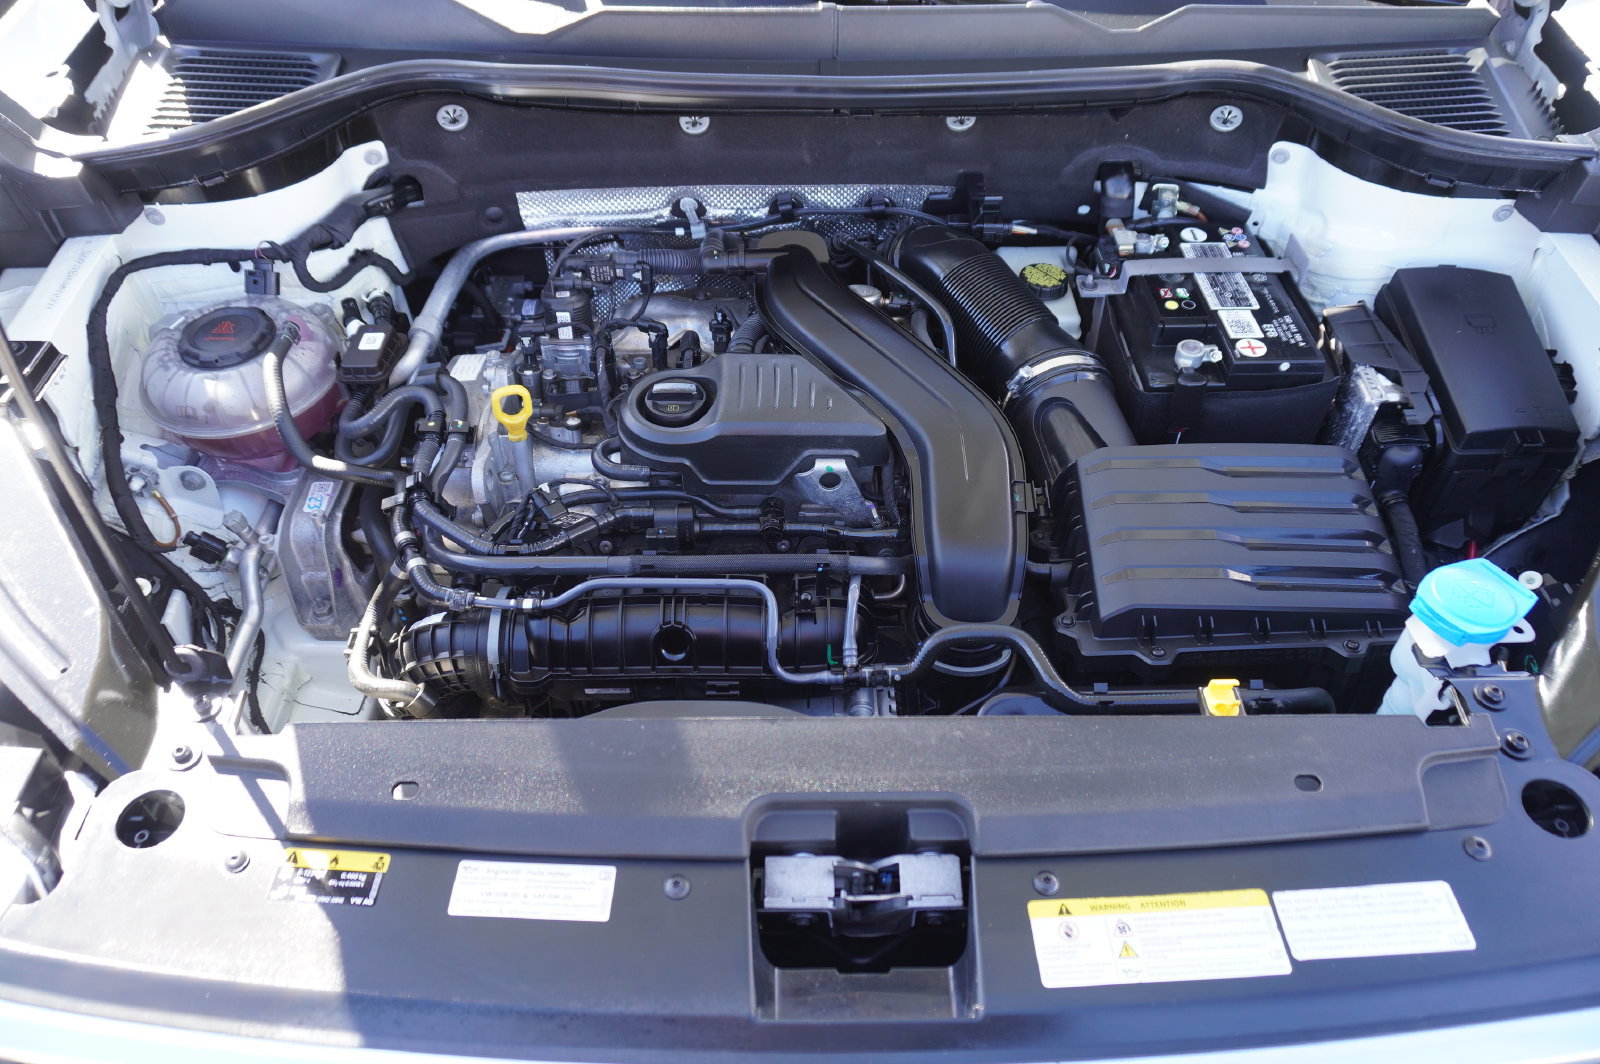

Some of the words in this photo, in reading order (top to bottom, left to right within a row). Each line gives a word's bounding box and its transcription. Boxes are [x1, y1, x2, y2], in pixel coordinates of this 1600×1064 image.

[1262, 324, 1278, 338] EFB
[486, 868, 509, 876] Engine
[362, 898, 374, 906] AG
[1089, 903, 1131, 913] WARNING
[1139, 899, 1186, 910] ATTENTION
